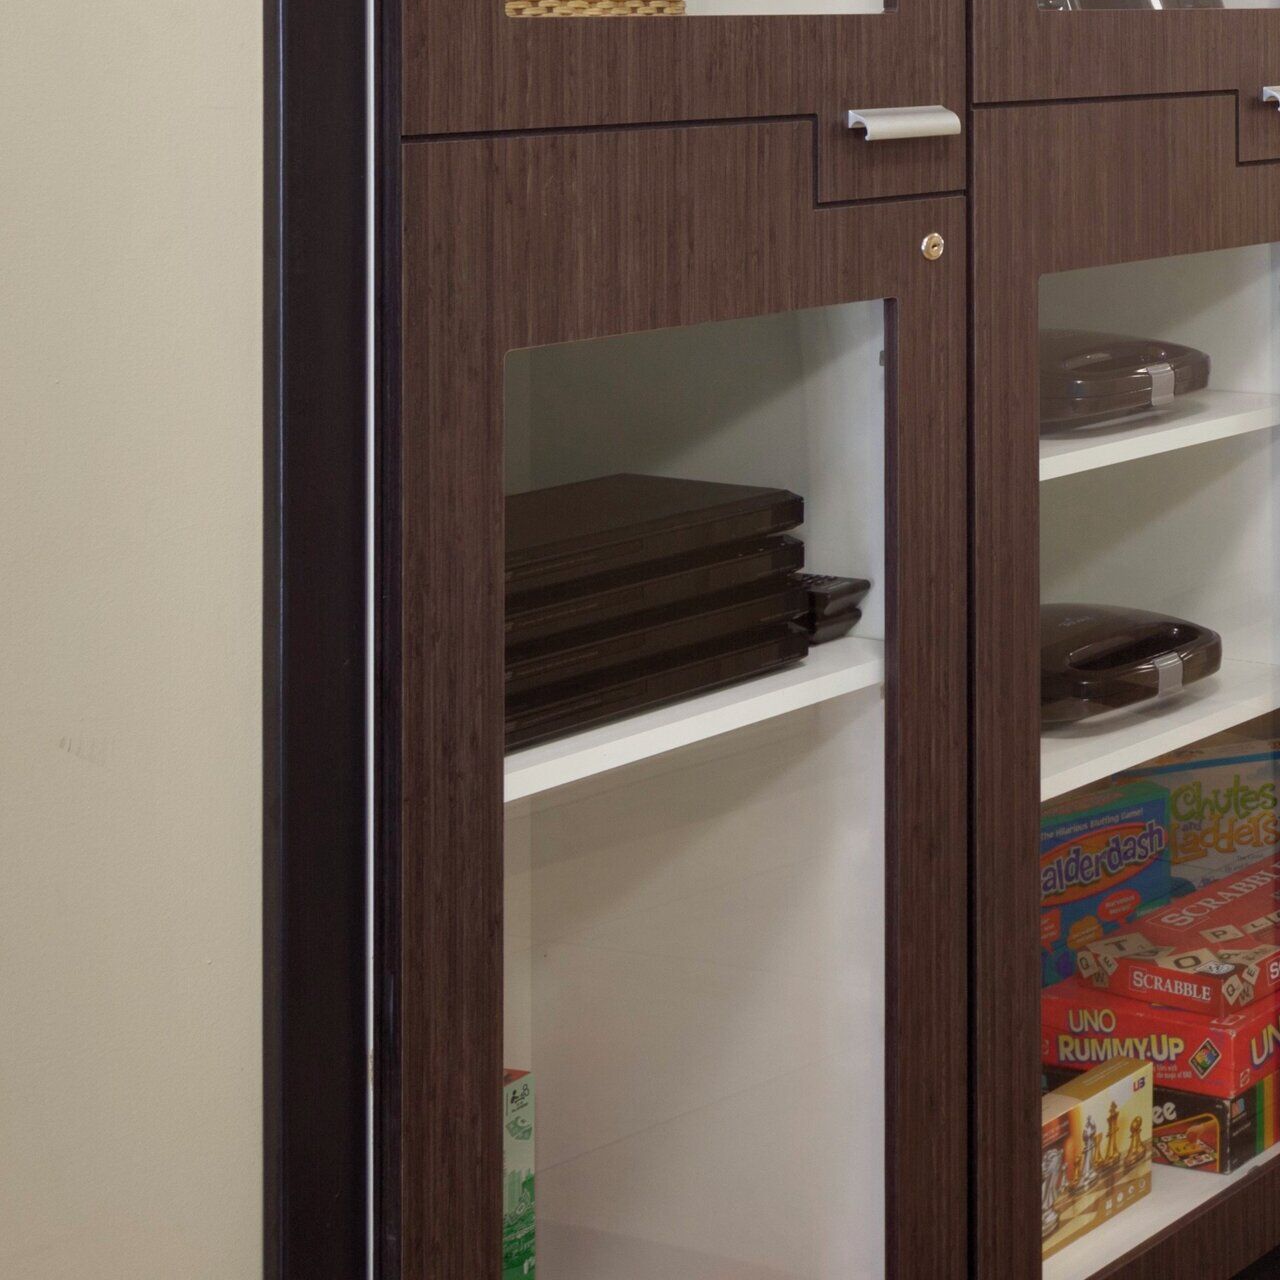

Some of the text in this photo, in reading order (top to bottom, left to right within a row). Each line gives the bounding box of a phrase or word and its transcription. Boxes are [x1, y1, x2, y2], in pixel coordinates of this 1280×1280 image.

[1170, 774, 1278, 820] Chutes
[1041, 819, 1165, 899] alderdash
[1170, 810, 1280, 865] Ladders
[1132, 970, 1211, 1002] SCRABBLE
[1069, 1008, 1116, 1033] UNO
